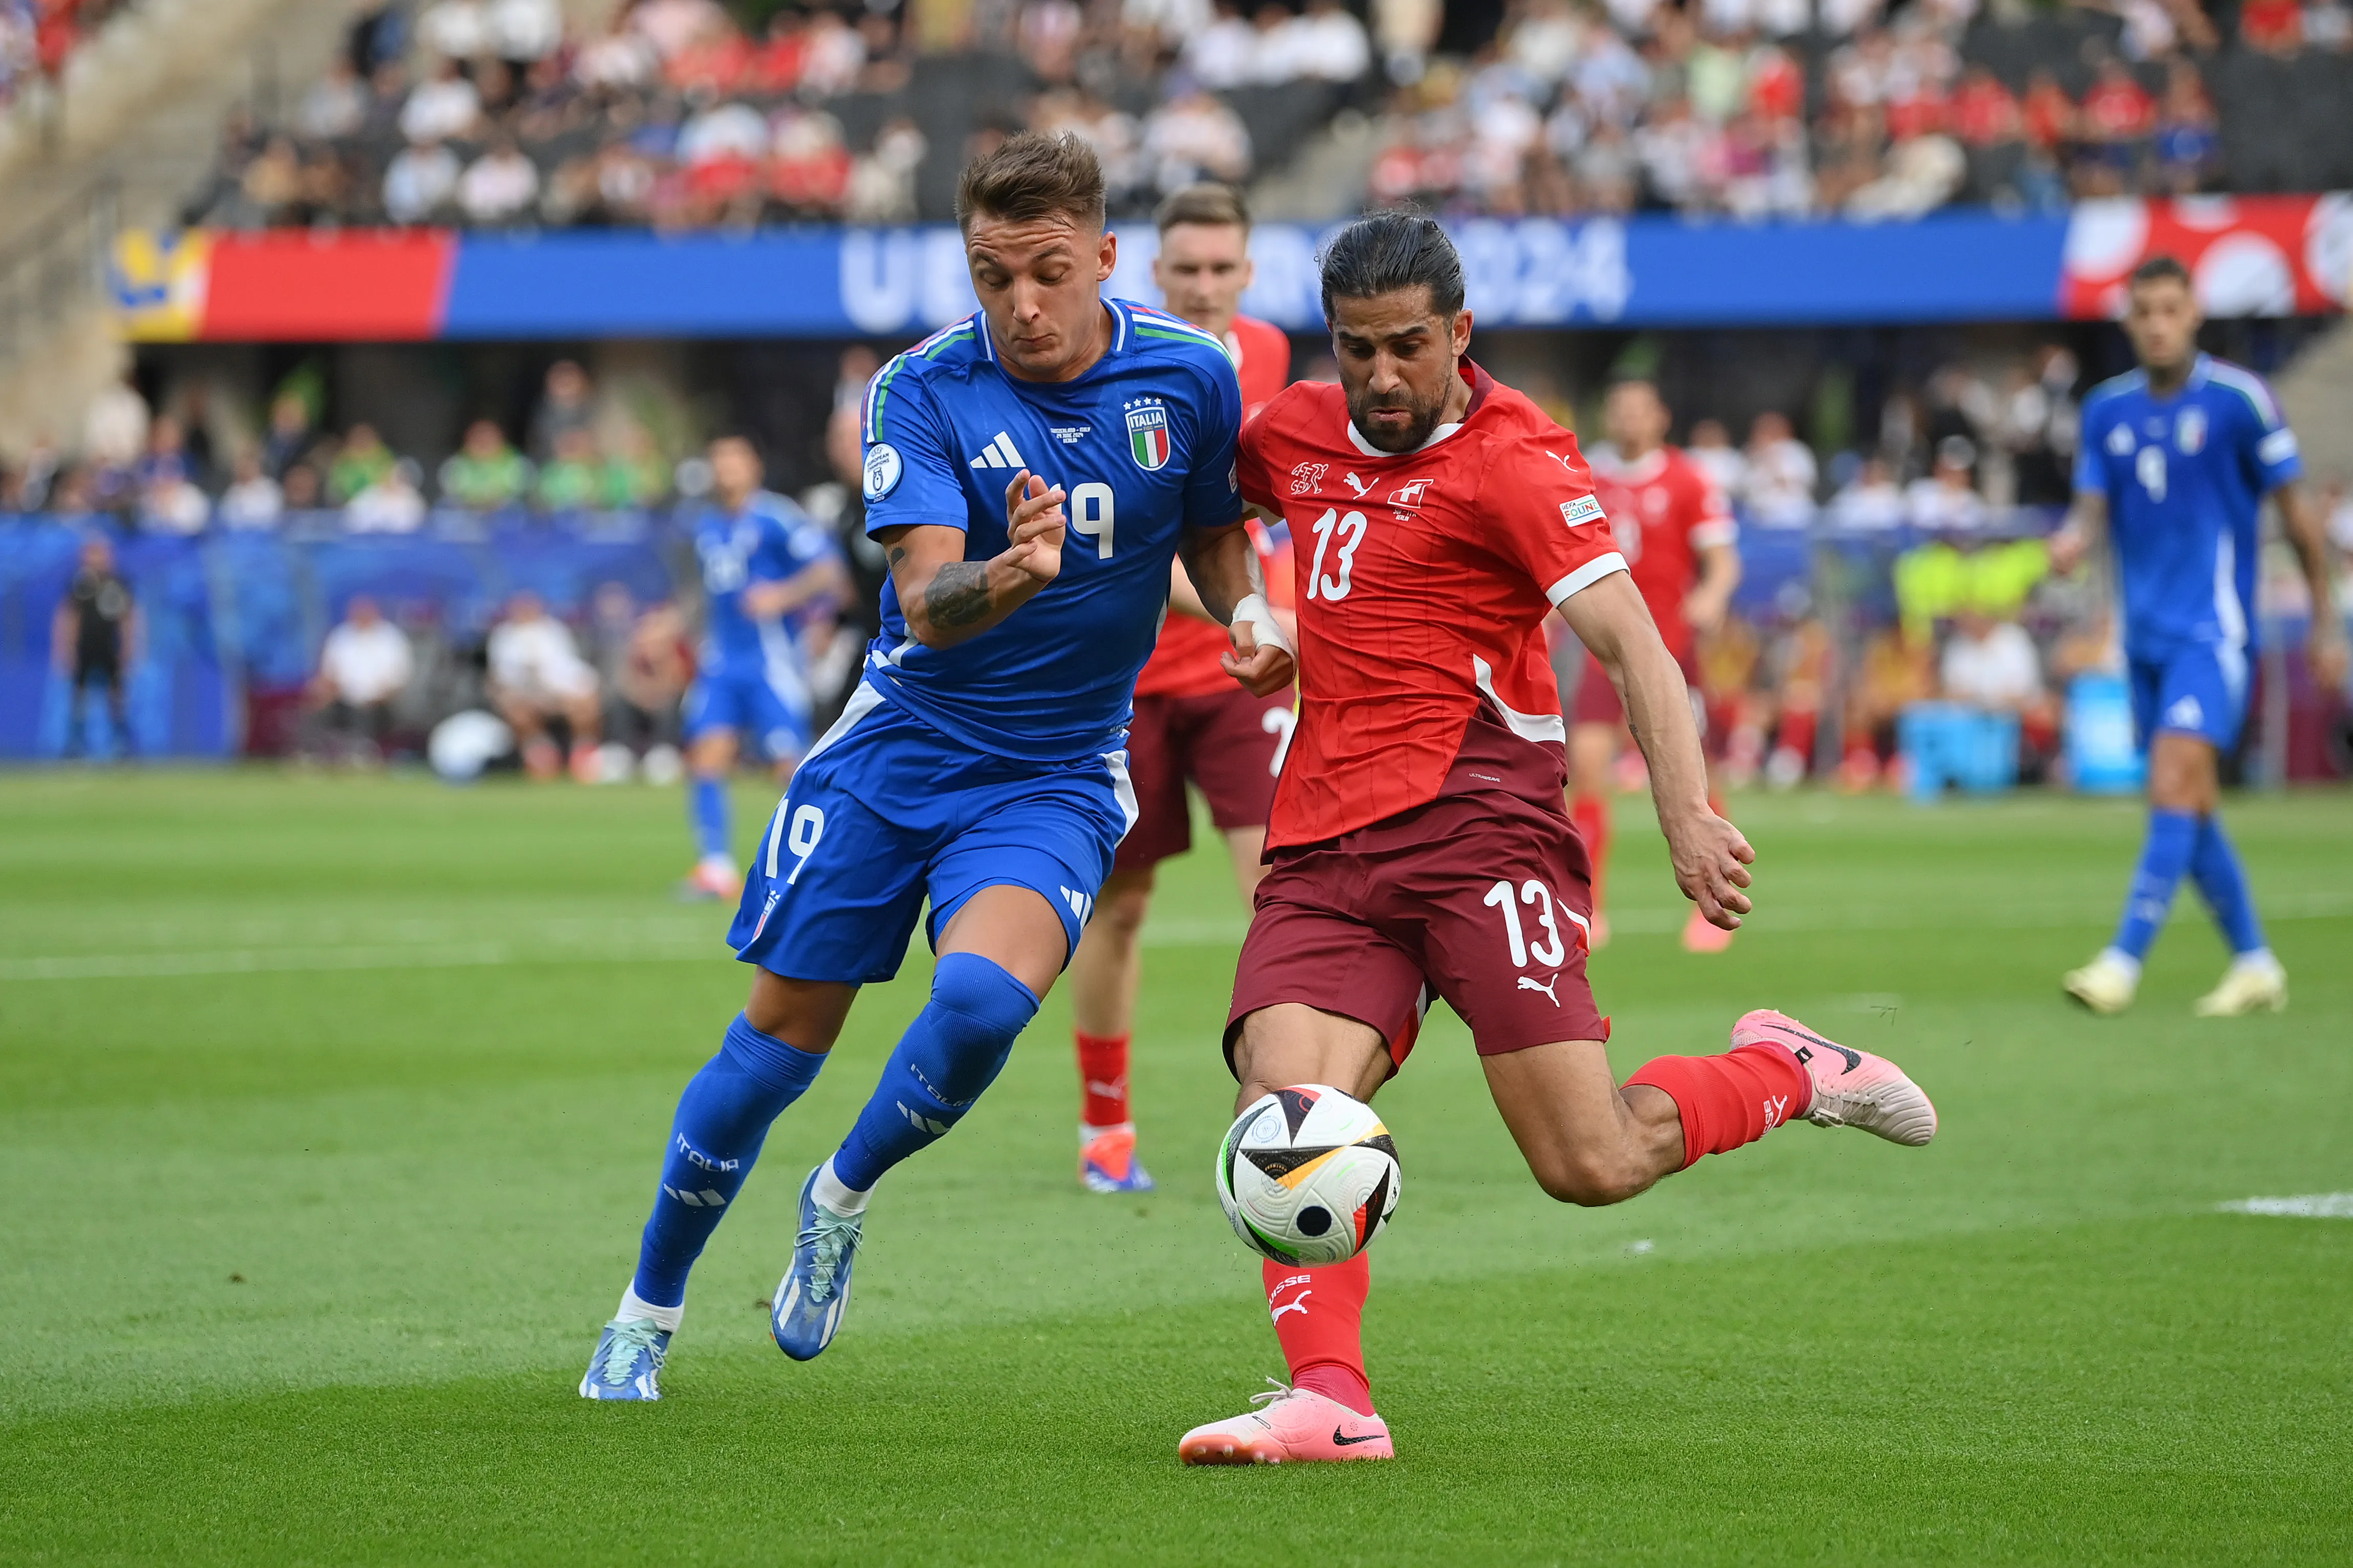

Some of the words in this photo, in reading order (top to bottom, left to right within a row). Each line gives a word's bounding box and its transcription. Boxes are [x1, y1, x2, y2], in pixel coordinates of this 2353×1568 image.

[1129, 411, 1164, 428] ITALIA
[867, 452, 889, 467] EUROPEAN
[1562, 502, 1576, 510] UEFA
[1307, 507, 1368, 601] 13
[765, 798, 825, 885] 19
[1484, 879, 1565, 967] 13
[911, 1064, 974, 1107] ITALIA
[676, 1132, 739, 1172] ITALIA
